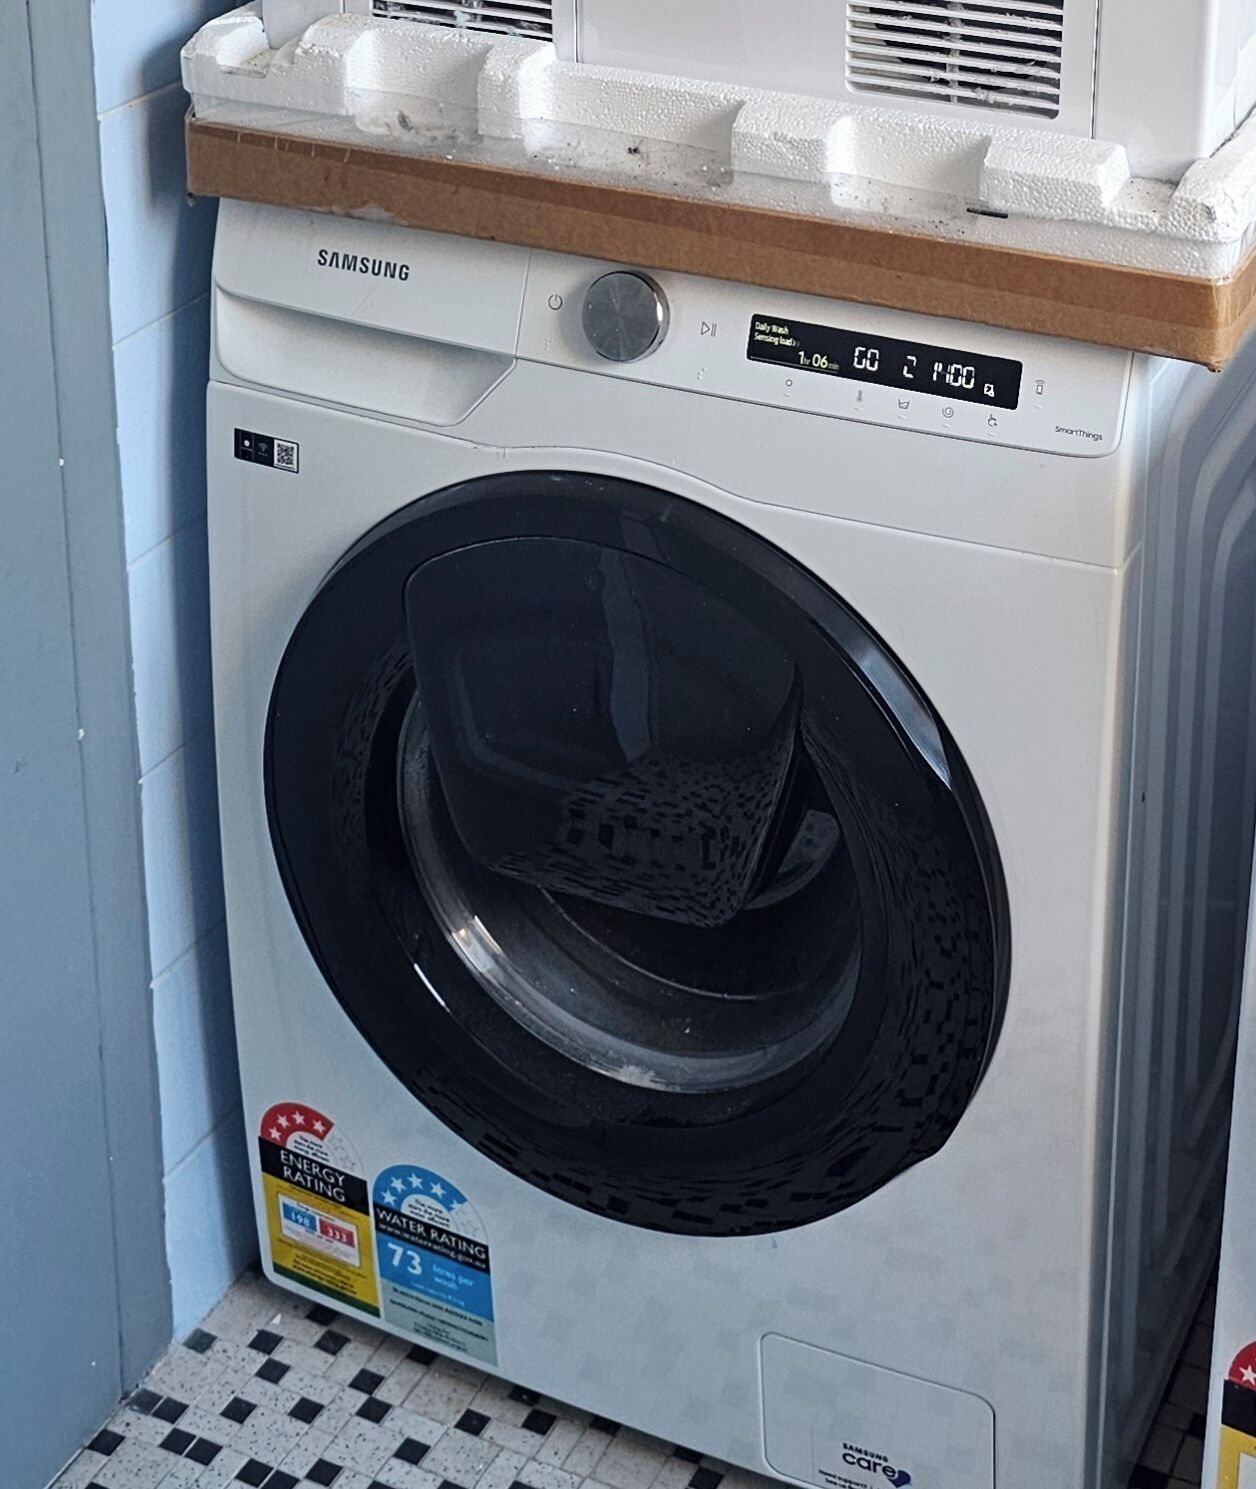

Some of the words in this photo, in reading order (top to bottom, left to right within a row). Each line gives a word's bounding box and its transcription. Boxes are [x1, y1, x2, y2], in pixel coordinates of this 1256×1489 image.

[317, 249, 410, 281] SAMSUNG
[754, 332, 779, 346] Sensing
[779, 336, 793, 346] load
[755, 321, 771, 333] Daily
[772, 324, 789, 335] Wash
[902, 355, 917, 379] 2
[1055, 425, 1103, 442] SmartThings
[280, 1150, 345, 1186] ENERGY
[283, 1166, 346, 1202] RATING
[376, 1207, 426, 1236] WATER
[430, 1228, 486, 1260] RATING
[387, 1242, 423, 1275] 73
[842, 1442, 889, 1463] SAMSUNG
[842, 1452, 897, 1479] care
